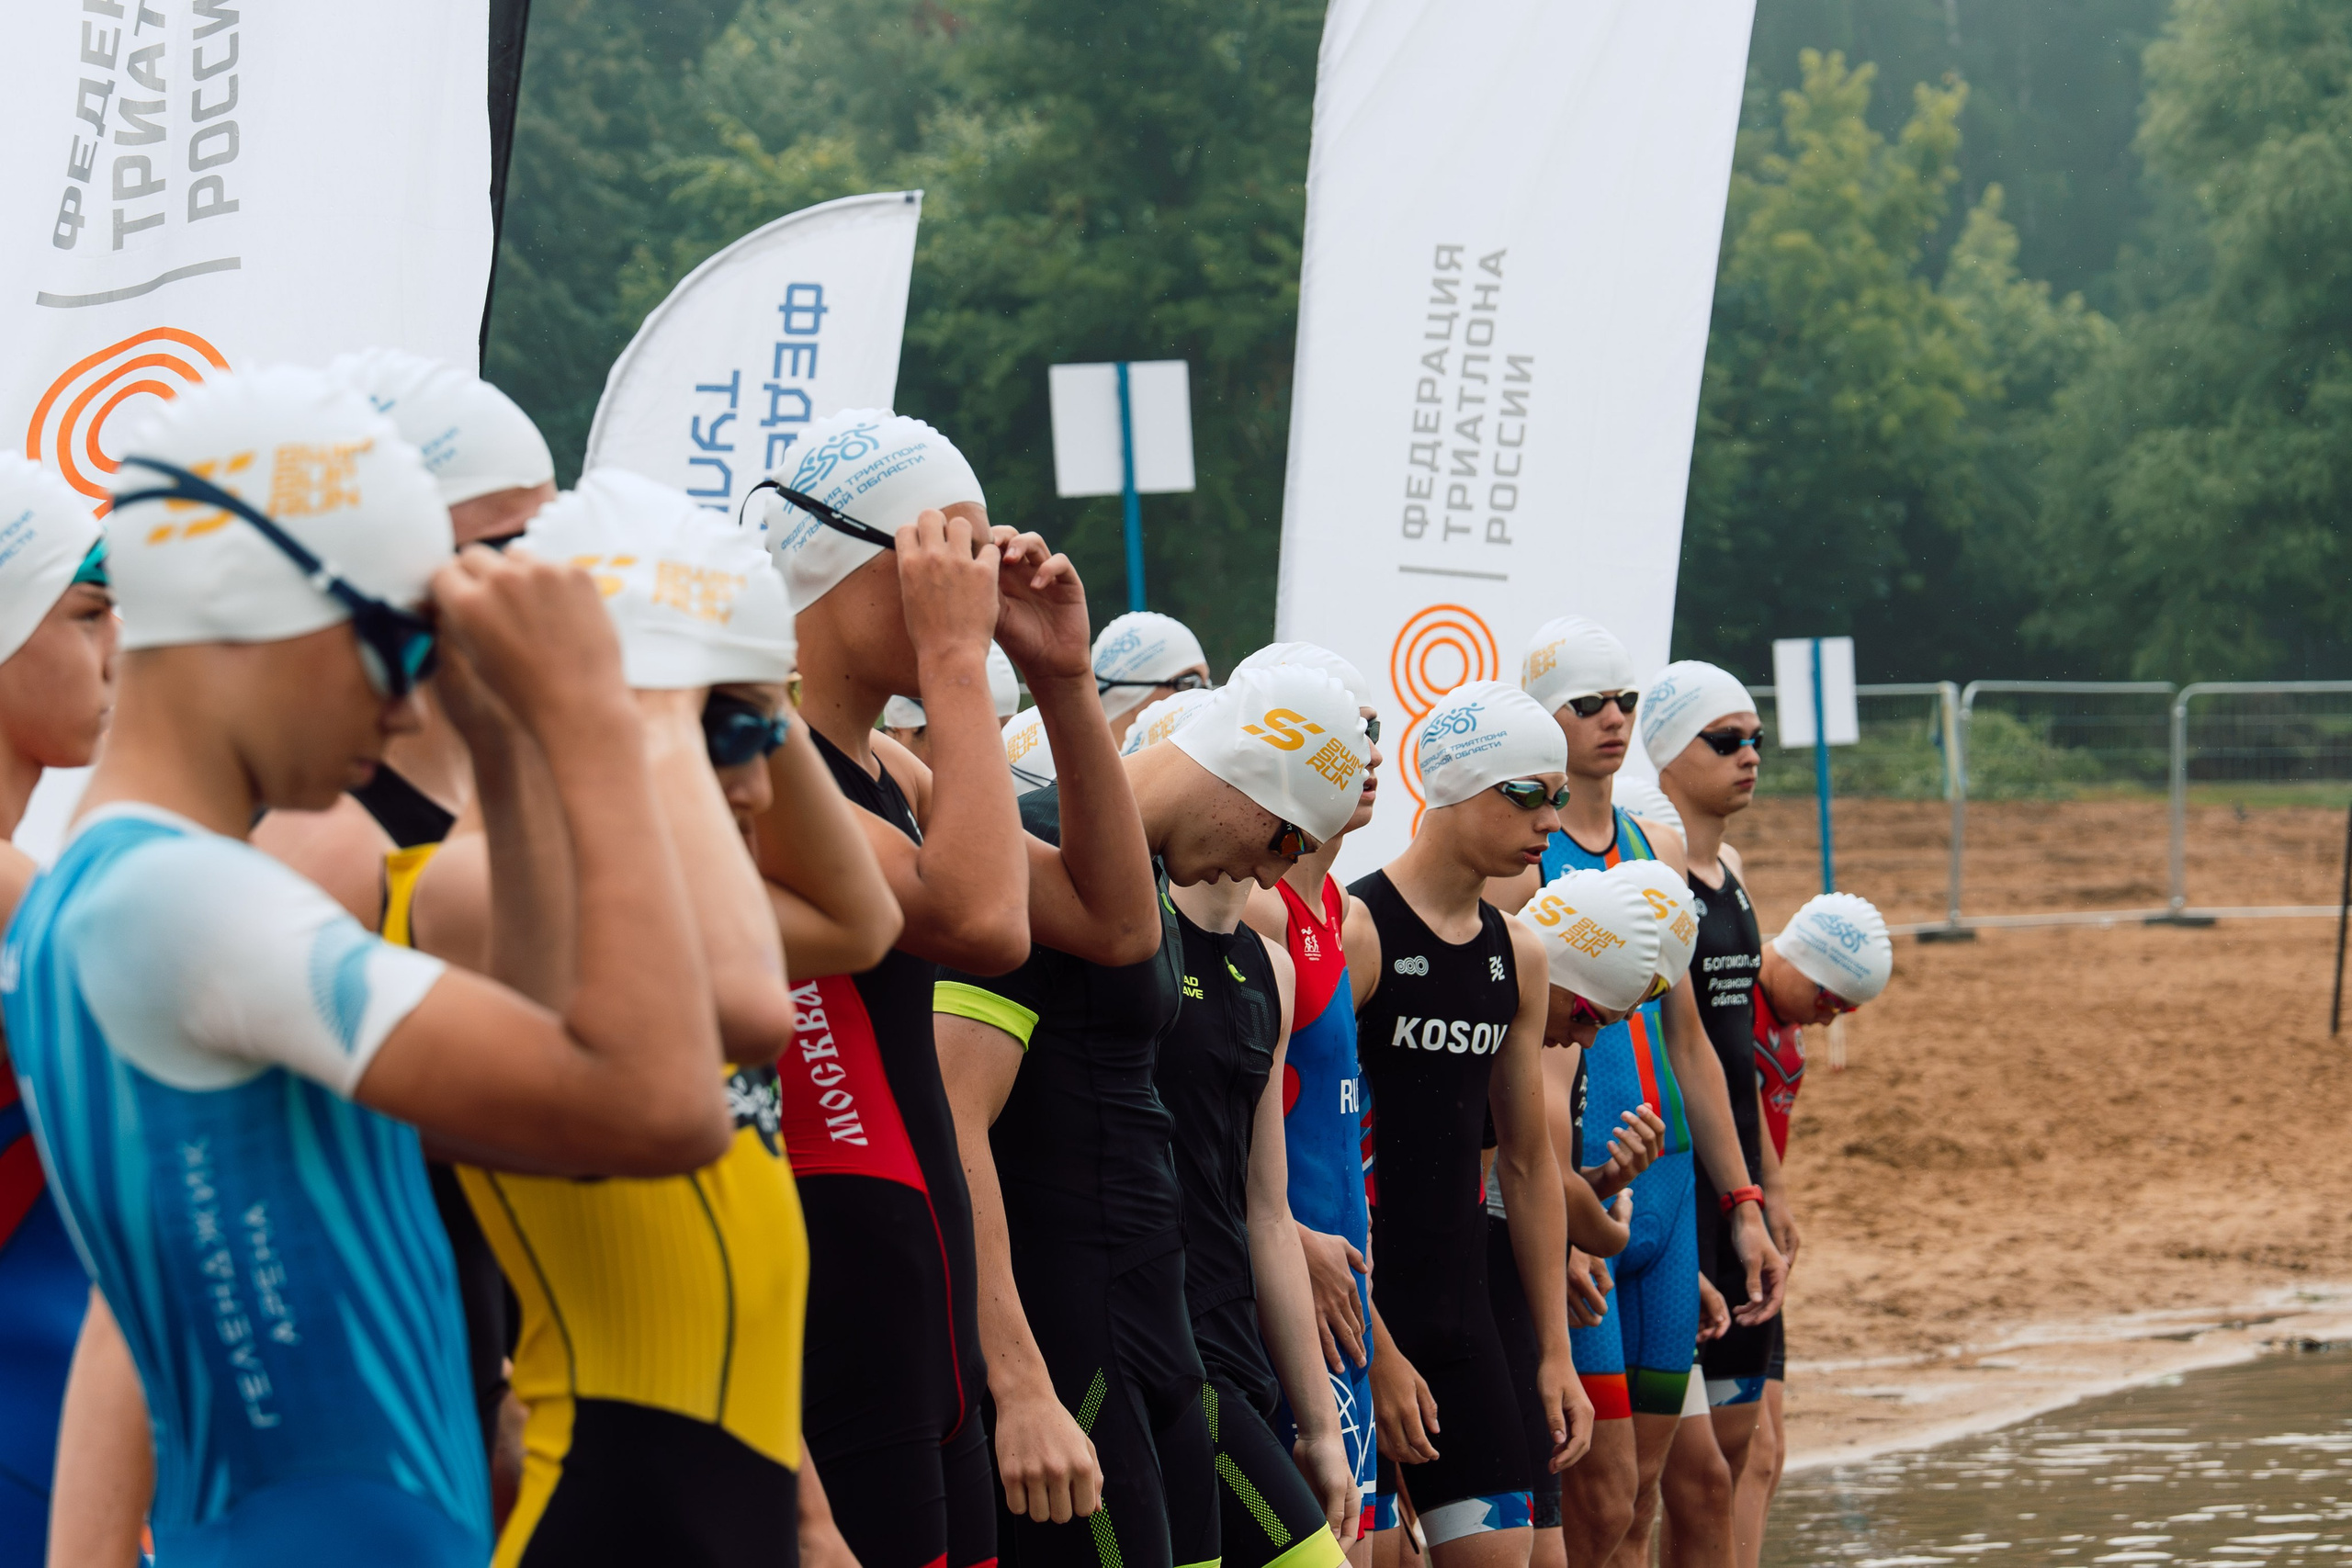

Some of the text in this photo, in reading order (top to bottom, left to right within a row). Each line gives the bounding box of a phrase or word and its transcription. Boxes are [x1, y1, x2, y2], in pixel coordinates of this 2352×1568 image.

[761, 283, 829, 480] ФЕДЕ
[1402, 244, 1464, 539] ФЕДЕРАЦИЯ
[1442, 247, 1508, 542] ТРИАТЛОНА
[1485, 355, 1534, 546] РОССИИ
[781, 442, 928, 550] ФЕДЕРИЯ ТРИАТЛОНА
[793, 454, 926, 552] ТУЛЬОЙ ОБЛАСТИ
[1326, 737, 1364, 774] SWIM
[1449, 730, 1508, 752] ТРИАТЛОНА
[1454, 740, 1502, 761] ОБЛАСТИ
[1305, 755, 1349, 792] RUN
[1316, 746, 1355, 778] SUP
[1558, 930, 1601, 959] RUN
[1569, 922, 1609, 950] SUP
[1577, 917, 1626, 949] SWIM
[1392, 1015, 1508, 1055] KOSOV
